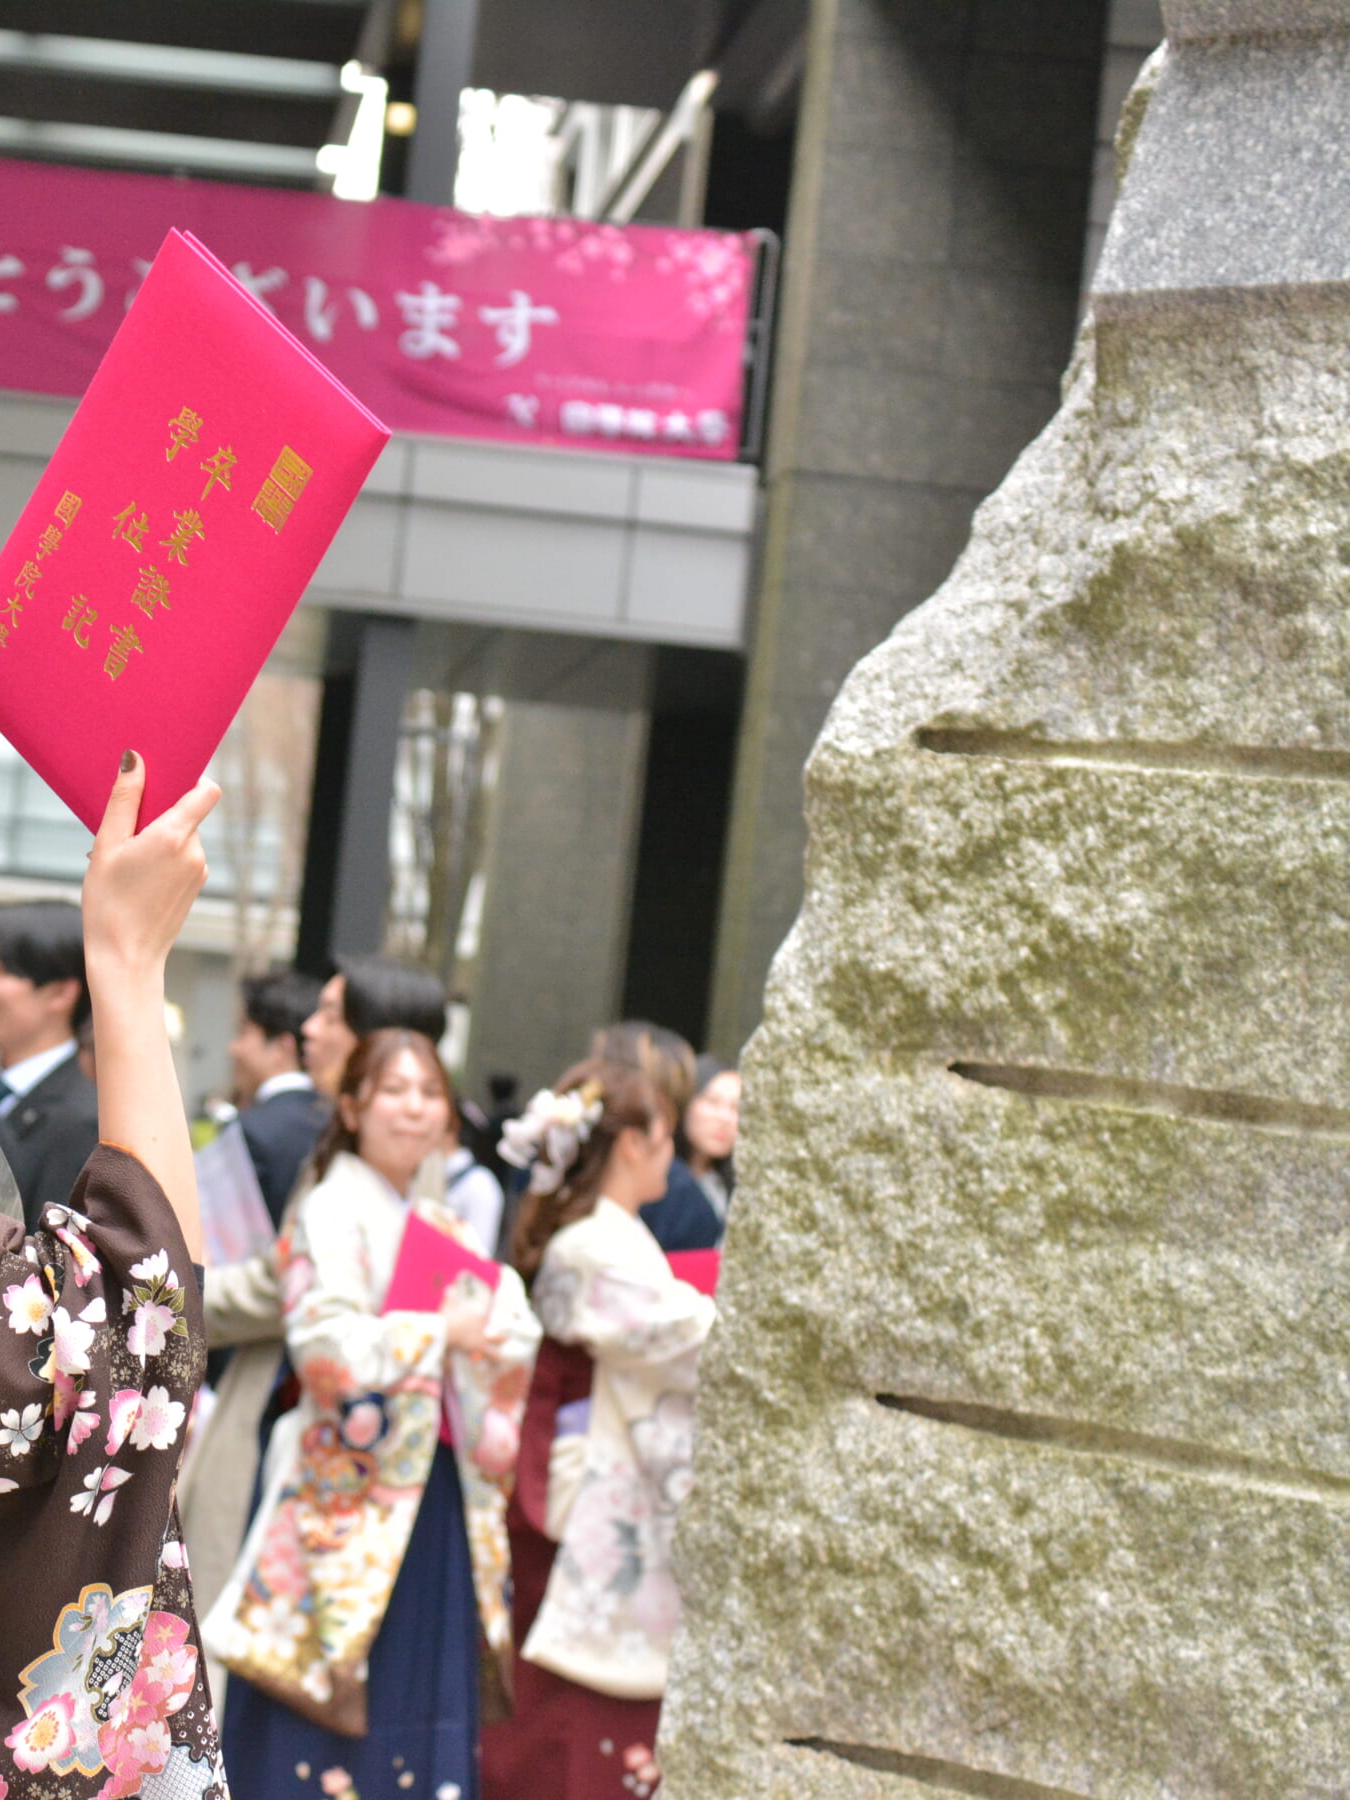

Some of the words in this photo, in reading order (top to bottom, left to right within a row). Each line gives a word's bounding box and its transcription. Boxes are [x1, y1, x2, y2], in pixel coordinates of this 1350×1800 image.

[61, 405, 204, 650] 學位記
[103, 444, 238, 681] 卒業證書
